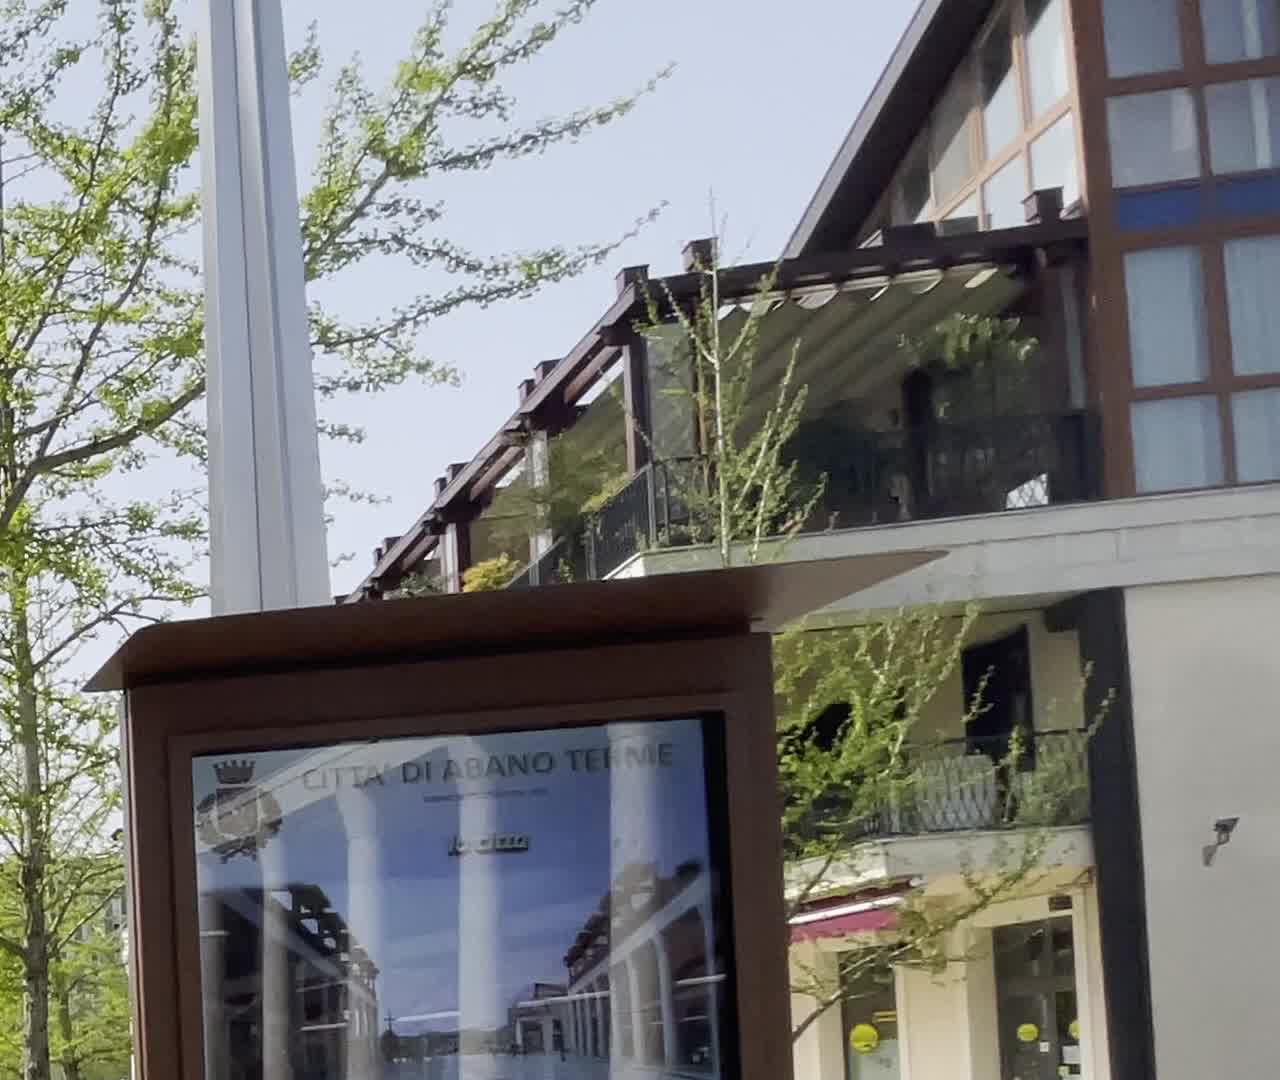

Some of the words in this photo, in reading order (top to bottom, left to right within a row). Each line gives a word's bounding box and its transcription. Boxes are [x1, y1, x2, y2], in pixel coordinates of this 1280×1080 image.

[402, 760, 431, 783] DI
[443, 752, 554, 782] ABANO
[565, 743, 672, 772] TERME
